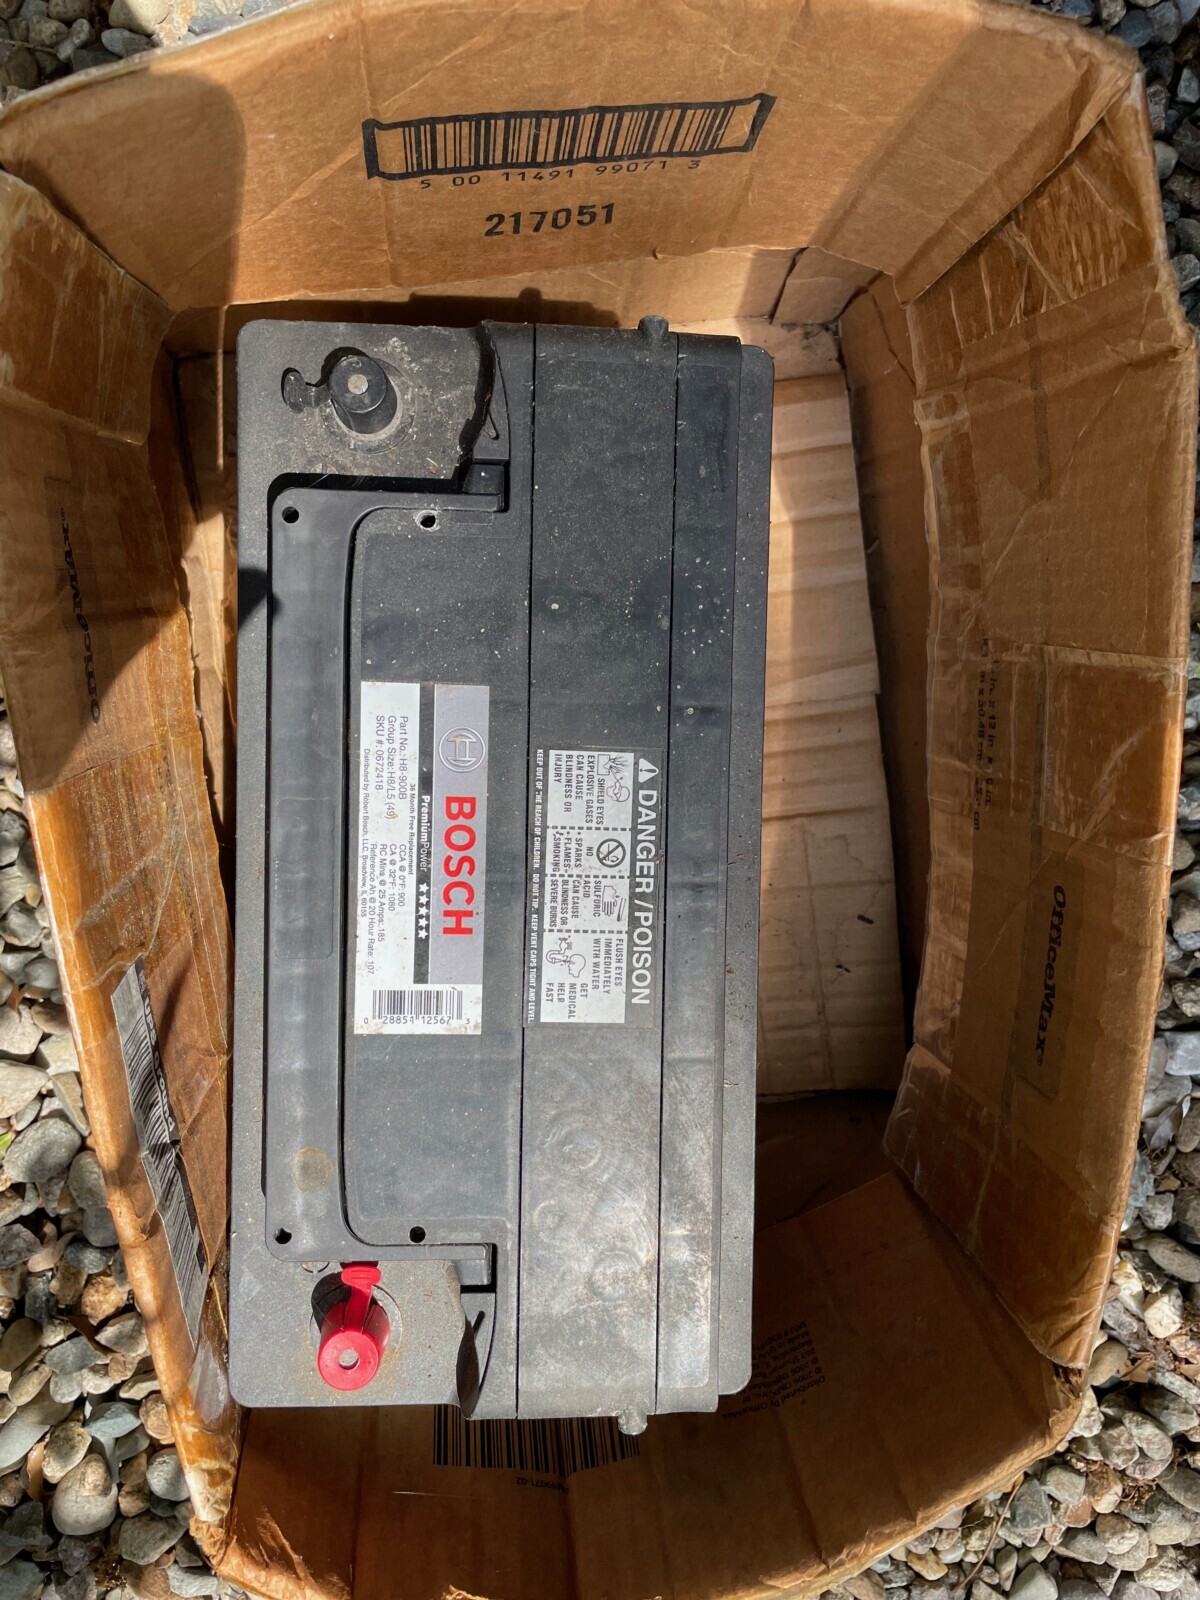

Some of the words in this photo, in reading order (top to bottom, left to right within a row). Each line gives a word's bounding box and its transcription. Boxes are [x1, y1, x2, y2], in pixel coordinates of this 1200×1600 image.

[420, 179, 431, 189] 5
[452, 174, 481, 187] 00
[502, 169, 575, 183] 11491
[595, 160, 668, 176] 99071
[687, 159, 701, 170] 3
[485, 203, 615, 237] 217051
[376, 716, 384, 737] SKU
[386, 716, 396, 744] Group
[399, 716, 408, 734] Part
[375, 750, 384, 790] 0672418
[387, 748, 396, 770] Size:
[554, 754, 562, 783] INJURY
[576, 755, 584, 772] CAN
[386, 771, 395, 799] H8/L5
[399, 758, 407, 800] H8-900B
[564, 754, 573, 798] BLINDNESS
[586, 755, 594, 796] EXPLOSIVE
[597, 778, 605, 804] SHIELD
[384, 802, 396, 819] (49)
[564, 802, 572, 812] OR
[596, 807, 604, 825] EYES
[419, 795, 430, 871] PremiumPower
[635, 790, 658, 893] DANGER
[379, 844, 386, 856] RC
[389, 844, 396, 855] CA
[398, 844, 406, 862] CCA
[552, 838, 561, 872] SMOKING
[564, 838, 572, 868] FLAMES
[586, 846, 593, 856] NO
[369, 844, 377, 882] Reference
[442, 796, 477, 936] BOSCH
[388, 868, 396, 889] 32°F:
[533, 874, 539, 882] DO
[572, 880, 580, 893] CAN
[583, 880, 591, 898] ACID
[369, 884, 376, 895] Ah
[379, 890, 386, 899] 25
[550, 879, 558, 903] SEVERE
[561, 880, 569, 915] BLINDNESS
[593, 880, 601, 917] SULFURIC
[368, 906, 376, 915] 20
[377, 902, 385, 925] Amps:
[572, 896, 580, 918] CAUSE
[561, 917, 568, 925] OR
[593, 938, 601, 958] WITH
[592, 962, 600, 990] WATER
[603, 938, 612, 994] IMMEDIATELY
[615, 966, 623, 986] EYES
[568, 983, 576, 1019] MEDICAL
[580, 983, 588, 998] GET
[382, 1016, 414, 1024] 28851
[422, 1016, 451, 1024] 12567
[142, 998, 158, 1048] UPS
[153, 1049, 176, 1133] Ground
